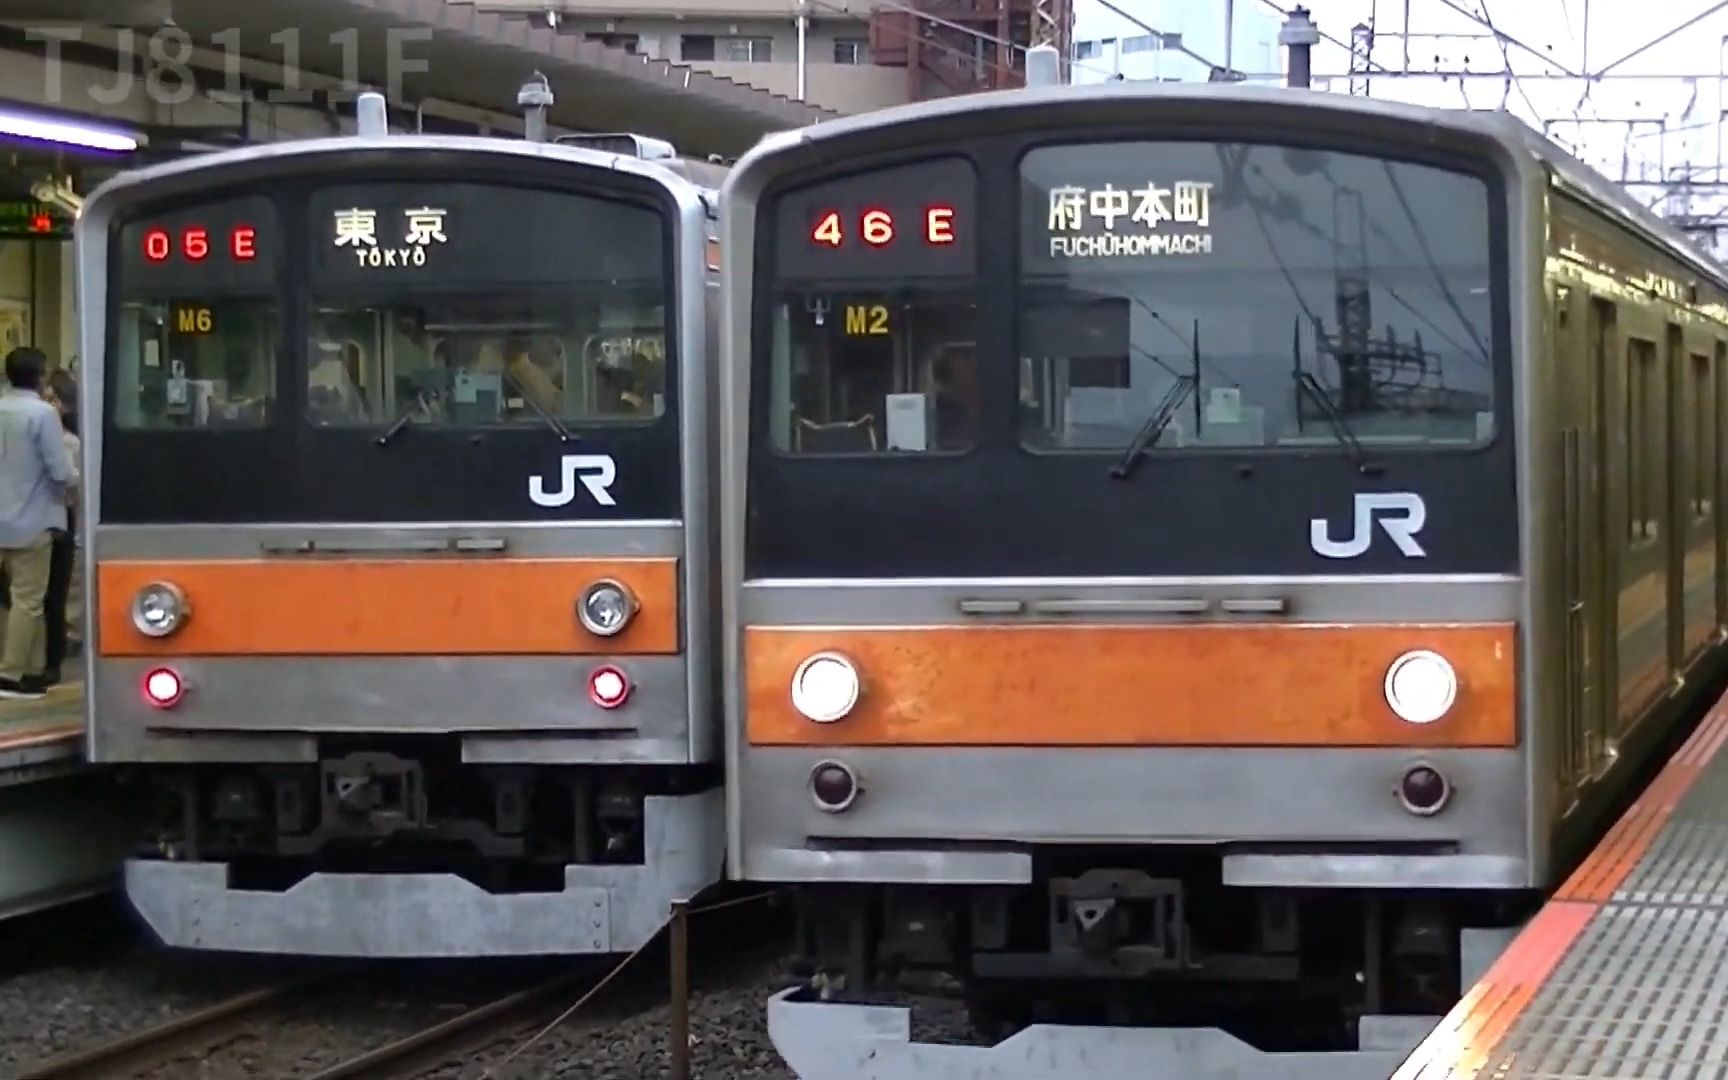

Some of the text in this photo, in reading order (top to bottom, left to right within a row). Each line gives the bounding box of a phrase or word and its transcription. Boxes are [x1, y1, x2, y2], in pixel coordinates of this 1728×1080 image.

[1048, 181, 1213, 230] 府中本町
[334, 207, 447, 246] 東京
[356, 246, 426, 266] TŌKYŌ
[1050, 232, 1212, 257] FUCHŪHOMMACHI
[179, 308, 212, 332] M6
[846, 305, 888, 334] M2
[529, 455, 616, 507] JR
[1311, 492, 1426, 558] JR
